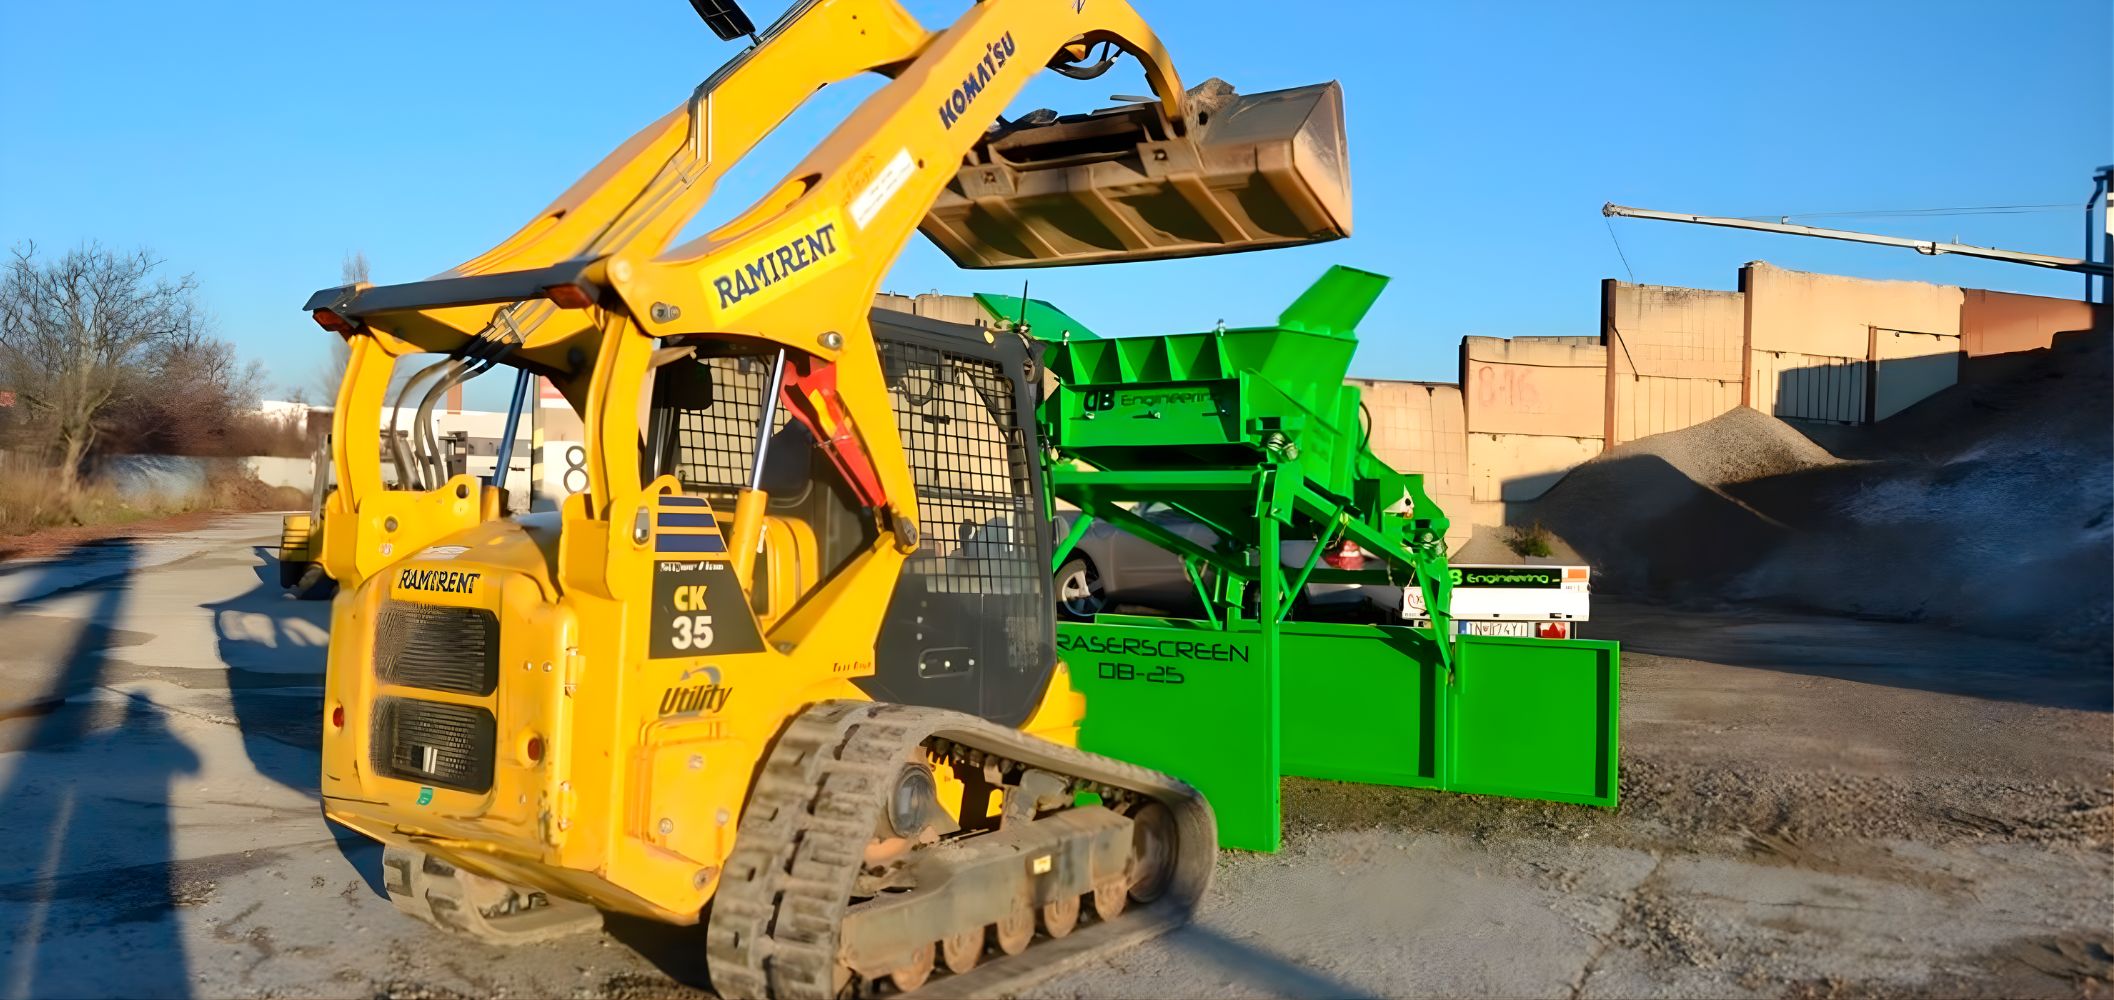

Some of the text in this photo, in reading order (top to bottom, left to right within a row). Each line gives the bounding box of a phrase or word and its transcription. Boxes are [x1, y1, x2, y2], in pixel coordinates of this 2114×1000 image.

[938, 30, 1016, 131] KOMATSU
[713, 222, 837, 310] RAMIRENT
[563, 445, 590, 494] 8
[398, 568, 481, 594] RAMIRENT
[673, 585, 708, 612] CK
[671, 615, 714, 650] 35
[1098, 661, 1185, 685] DB-25
[658, 683, 733, 715] Utility
